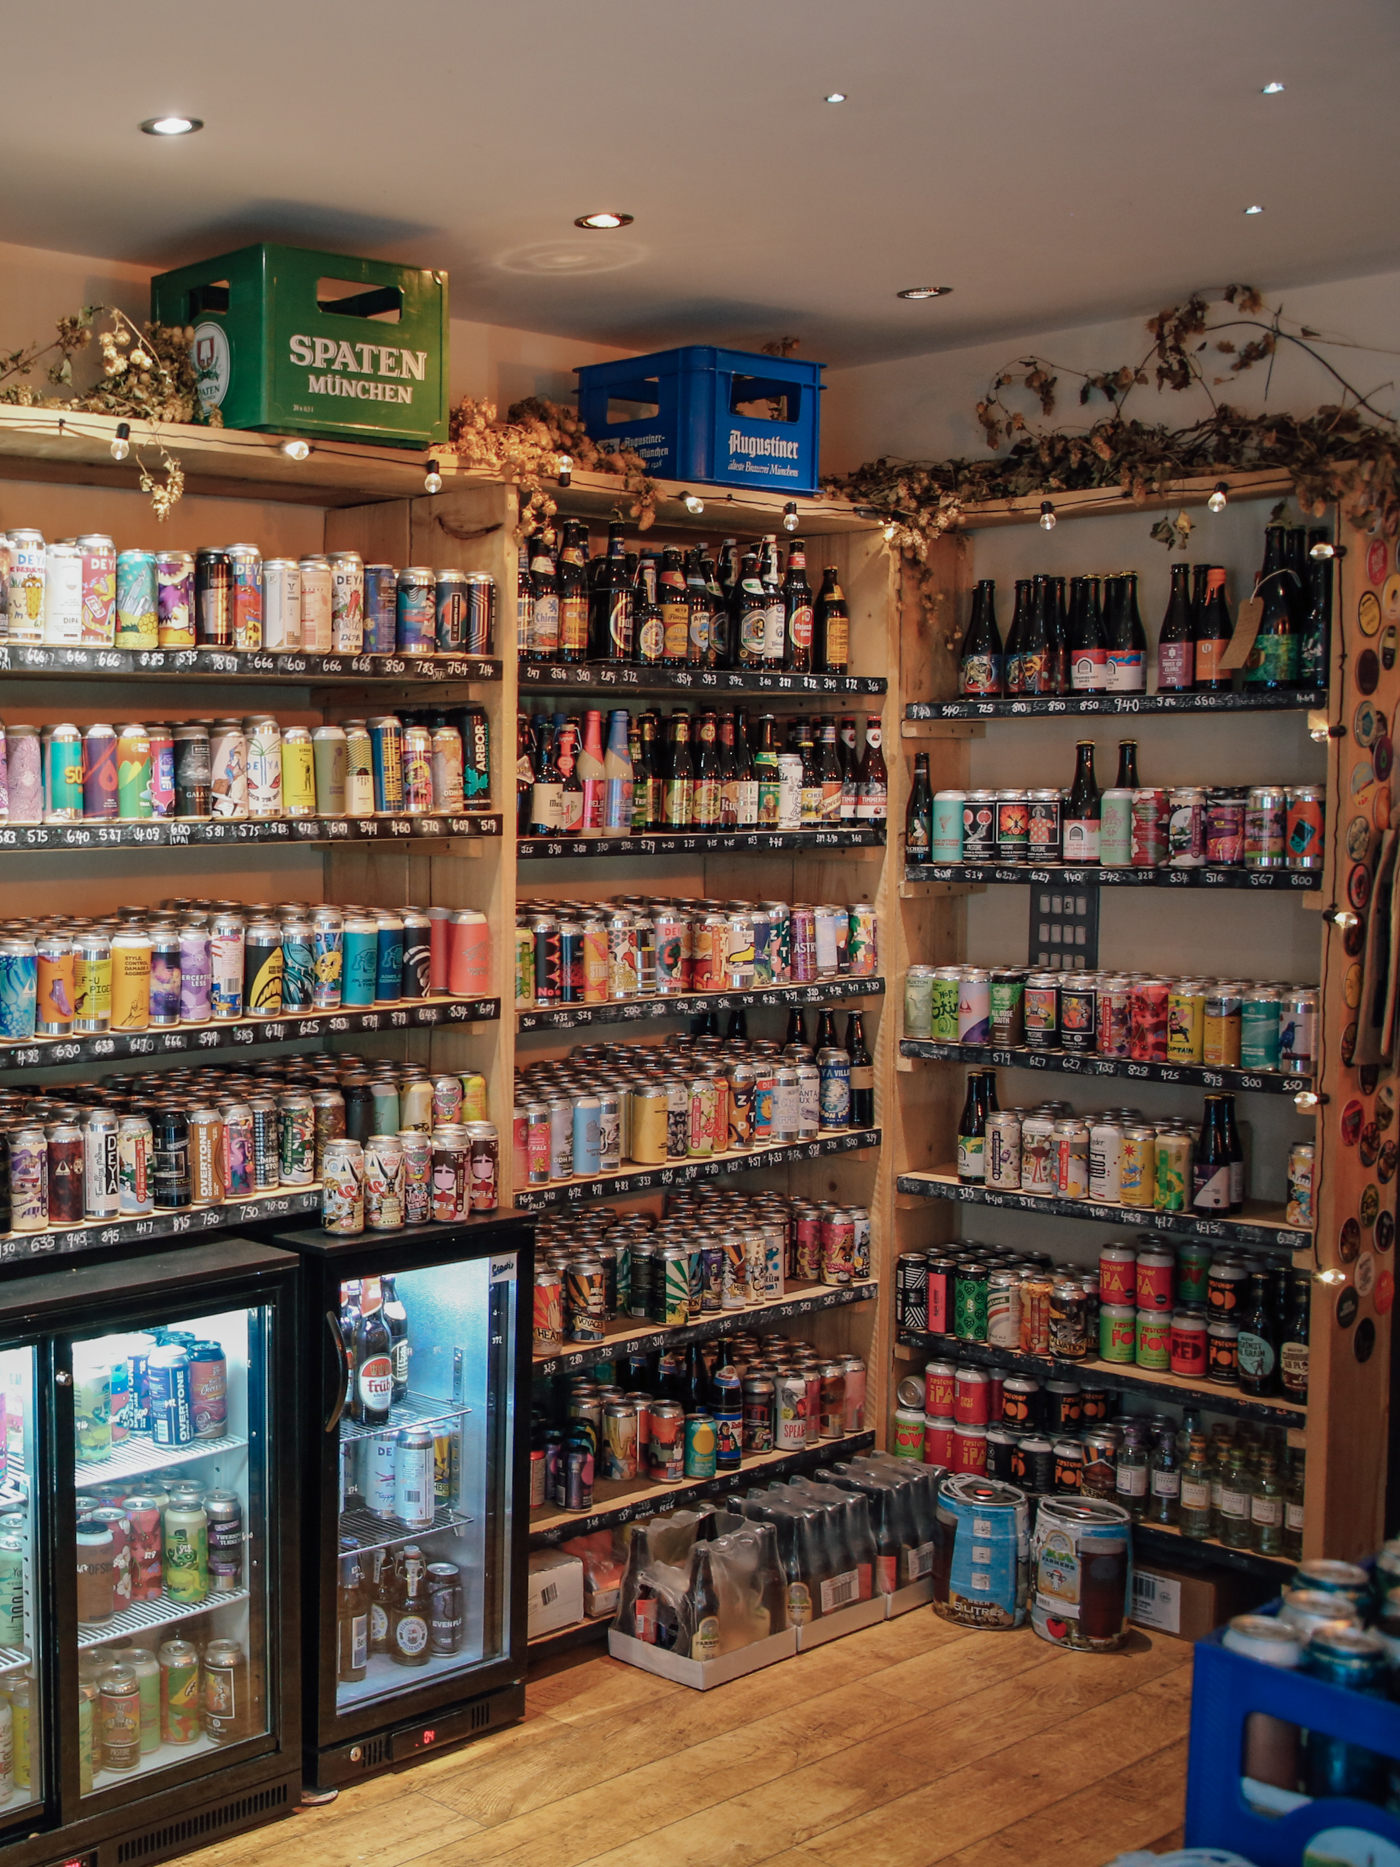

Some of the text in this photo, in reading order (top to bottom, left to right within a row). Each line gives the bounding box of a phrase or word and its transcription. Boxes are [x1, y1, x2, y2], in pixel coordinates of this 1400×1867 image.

[289, 334, 427, 381] SPATEN
[308, 375, 413, 404] MÜNCHEN
[729, 430, 798, 459] Augustiner
[63, 617, 78, 625] DIPA
[67, 650, 87, 663] 666
[254, 656, 273, 669] 666
[288, 658, 306, 671] 600
[323, 658, 341, 671] 666
[416, 660, 433, 675] 783
[448, 660, 468, 675] 754
[551, 670, 567, 680] 356
[623, 671, 638, 682] 372
[977, 703, 994, 713] 725
[1048, 700, 1066, 711] 850
[1080, 700, 1099, 712] 850
[1114, 697, 1139, 711] 940
[475, 725, 486, 772] ARBOR
[27, 829, 48, 842] 575
[171, 823, 191, 835] 600
[206, 824, 225, 838] 581
[67, 829, 90, 844] 640
[641, 841, 656, 853] 579
[965, 869, 983, 880] 534
[1031, 871, 1049, 882] 627
[1100, 870, 1120, 881] 542
[1170, 871, 1189, 883] 534
[1250, 874, 1273, 885] 567
[81, 976, 100, 986] F-U
[300, 1020, 320, 1034] 625
[993, 1051, 1011, 1064] 579
[1029, 1054, 1046, 1067] 627
[1063, 1057, 1080, 1069] 627
[1128, 1063, 1148, 1076] 828
[1160, 1069, 1179, 1080] 425
[1241, 1076, 1262, 1088] 300
[1282, 1079, 1302, 1091] 550
[106, 1135, 117, 1195] DEYA
[615, 1181, 629, 1192] 483
[639, 1176, 651, 1186] 333
[201, 1212, 219, 1225] 750
[240, 1206, 258, 1221] 750
[1155, 1215, 1173, 1228] 417
[31, 1235, 55, 1251] 635
[67, 1232, 87, 1246] 945
[652, 1333, 664, 1347] 310
[626, 1342, 639, 1353] 270
[570, 1354, 583, 1365] 280
[177, 1371, 186, 1441] OVERTONE
[1042, 1556, 1076, 1571] FARMERS
[953, 1602, 1004, 1616] 5 LITRES
